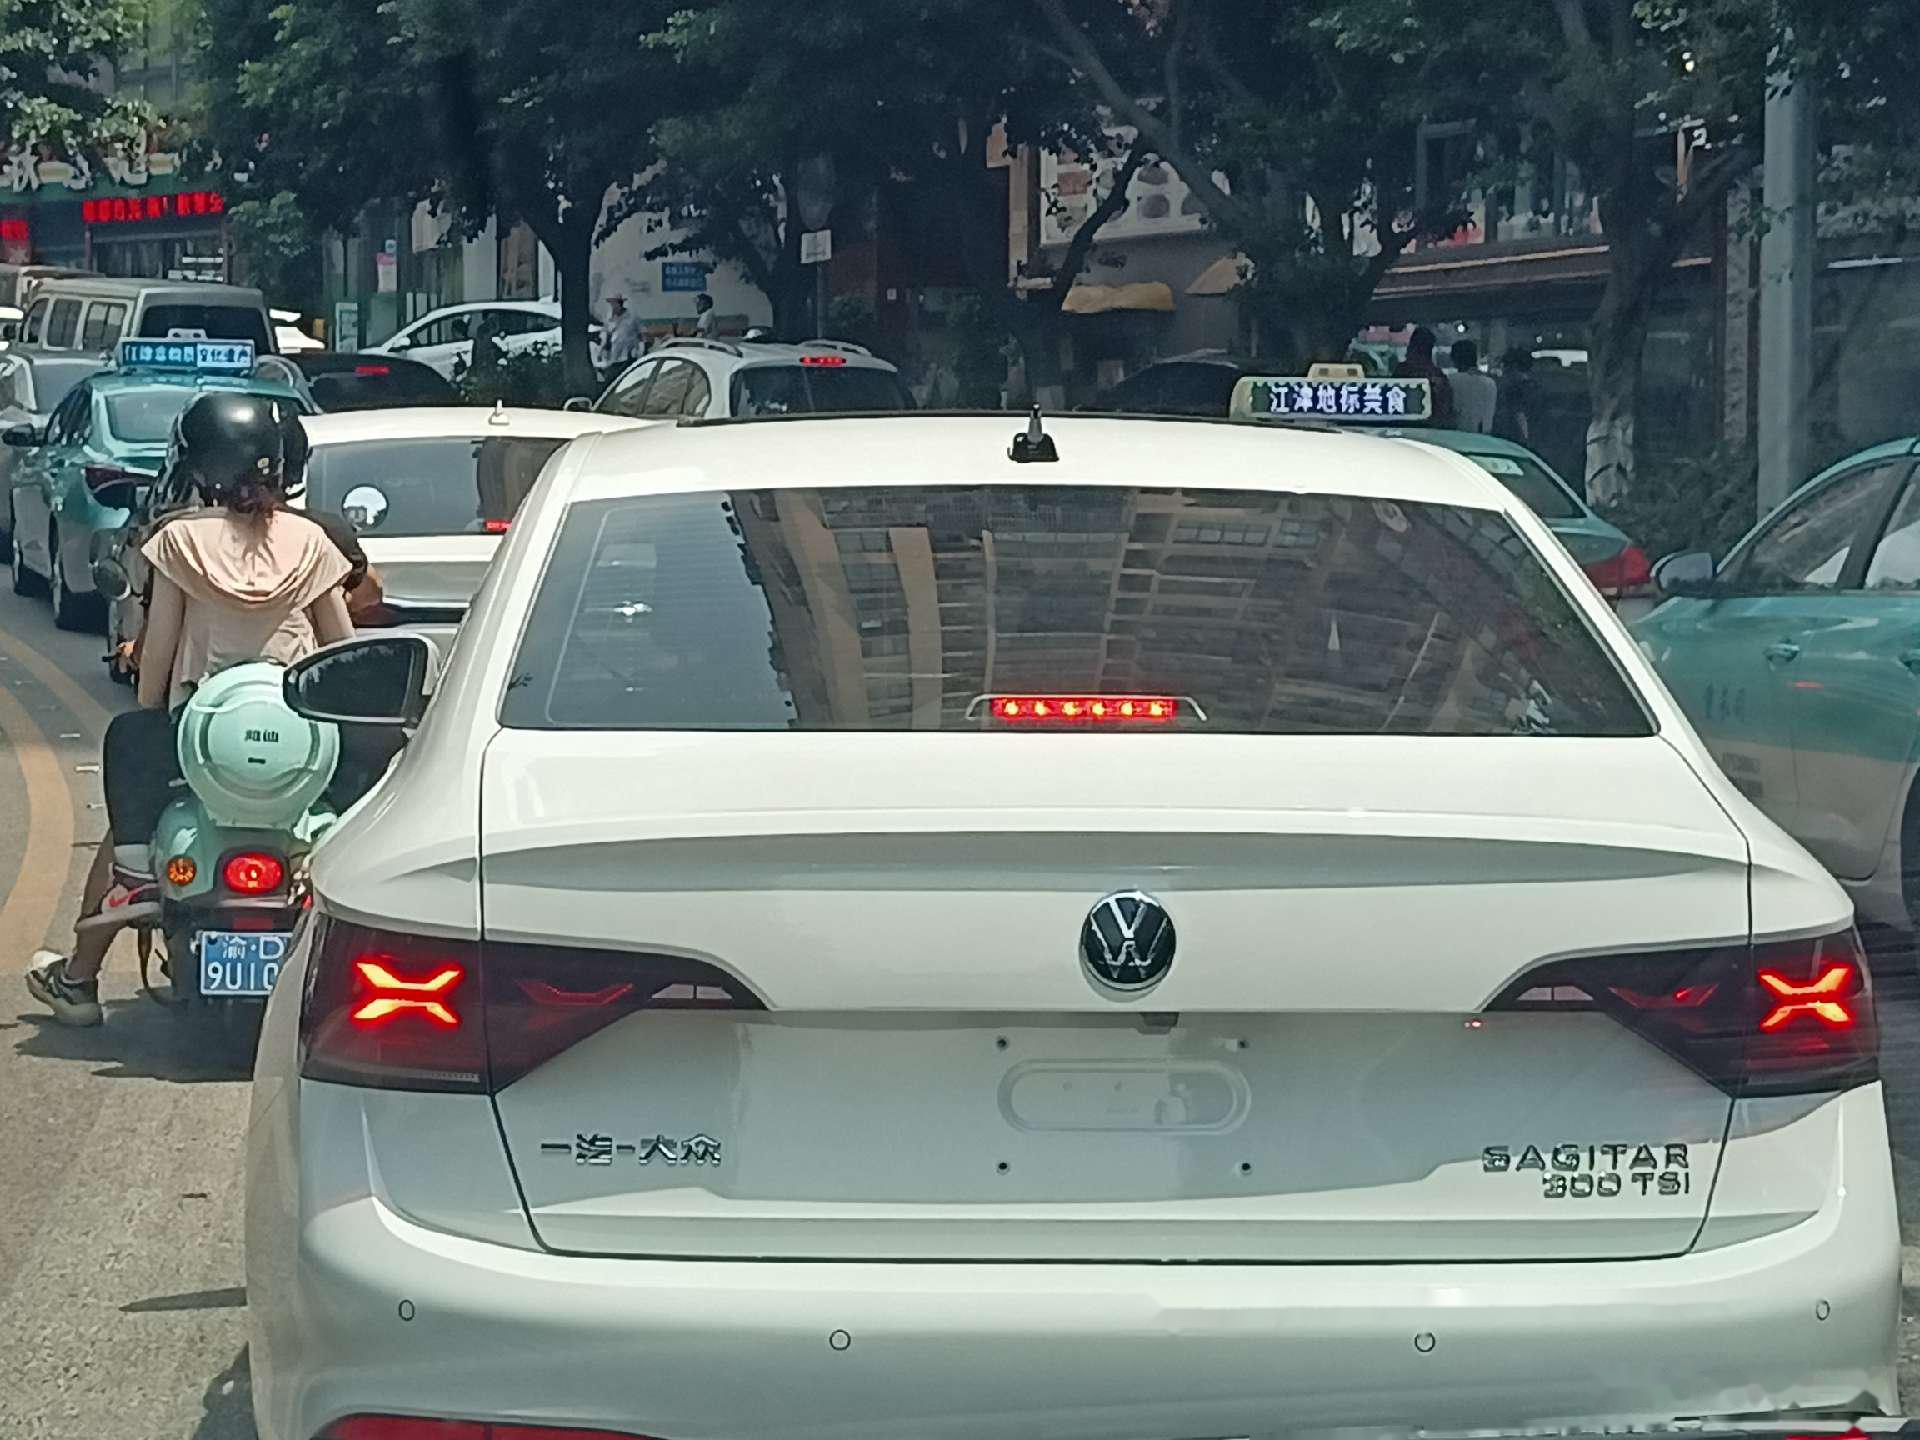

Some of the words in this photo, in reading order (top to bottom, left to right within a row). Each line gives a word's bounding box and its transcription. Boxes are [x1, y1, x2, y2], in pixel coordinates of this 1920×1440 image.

[1482, 1143, 1689, 1172] SAGITAR
[1542, 1172, 1622, 1199] 300
[1631, 1171, 1690, 1196] TSI
